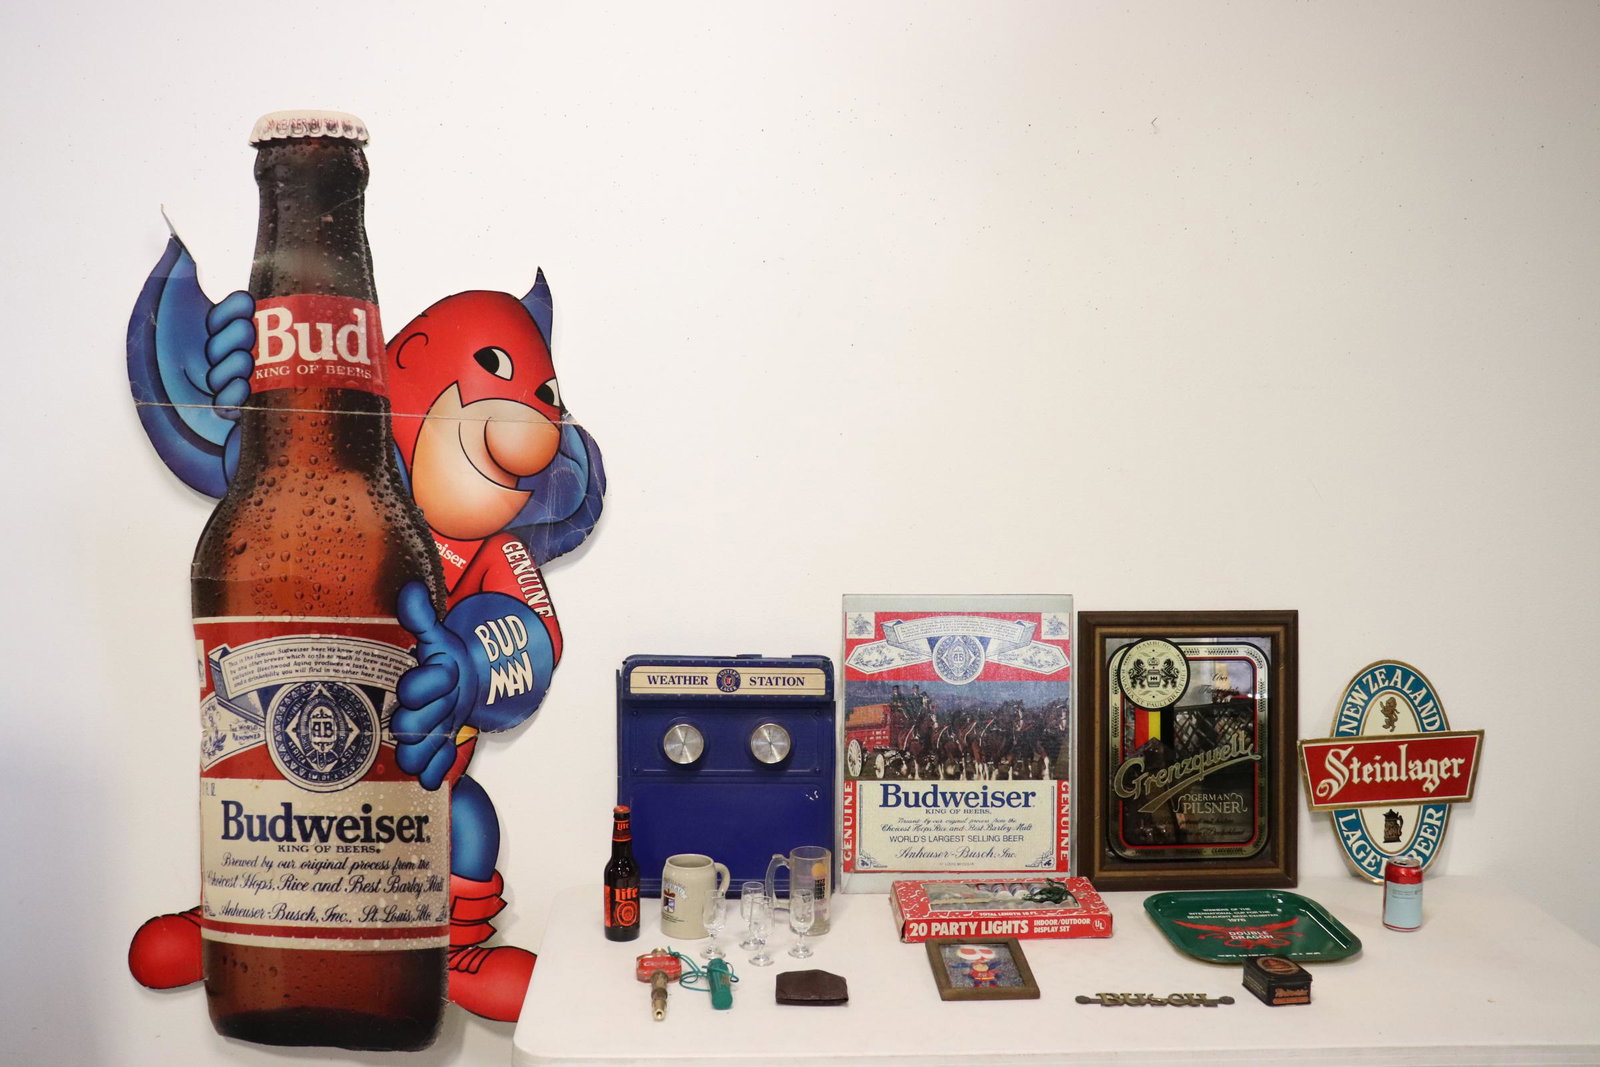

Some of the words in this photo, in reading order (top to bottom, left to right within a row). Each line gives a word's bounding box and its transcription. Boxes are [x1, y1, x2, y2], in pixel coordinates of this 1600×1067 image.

[255, 307, 371, 366] Bud
[255, 365, 291, 380] KING
[296, 364, 319, 375] OF
[325, 365, 372, 379] BEERS
[474, 615, 528, 663] BUD
[254, 650, 275, 659] famous
[370, 651, 388, 660] brand
[264, 656, 284, 664] brewer
[363, 657, 378, 665] brew
[256, 662, 291, 672] Beechwood
[247, 670, 280, 683] drinkability
[341, 668, 359, 676] other
[360, 670, 375, 679] beer
[384, 676, 396, 685] any
[486, 651, 533, 705] MAN
[647, 674, 709, 686] WEATHER
[749, 676, 806, 687] STATION
[1339, 685, 1369, 736] NEW
[1363, 668, 1441, 731] ZEALAND
[287, 741, 308, 764] AFRICA
[341, 744, 357, 764] ASIA
[1114, 731, 1256, 800] Grenzquell
[1316, 743, 1466, 801] Steinlager
[879, 783, 1037, 808] Budweiser
[1189, 793, 1230, 802] GERMAN
[1183, 801, 1242, 814] PILSNER
[220, 799, 430, 844] Budweiser
[616, 823, 630, 831] Lite
[843, 780, 853, 862] GENUINE
[880, 823, 912, 832] Choicest
[965, 823, 984, 832] Best
[983, 823, 1012, 833] Barley
[1013, 822, 1033, 832] Malt
[1060, 781, 1070, 861] GENUINE
[928, 834, 965, 843] LARGEST
[967, 834, 1001, 843] SELLING
[1002, 834, 1024, 842] BEER
[278, 845, 310, 853] KING
[314, 845, 331, 854] OF
[997, 847, 1017, 859] Inc.
[220, 851, 259, 868] Brewed
[260, 855, 274, 872] by
[276, 860, 297, 869] our
[299, 856, 349, 875] original
[347, 860, 390, 875] process
[390, 856, 416, 875] from
[416, 858, 430, 870] the
[276, 872, 310, 892] Rice
[311, 876, 344, 893] and
[344, 874, 382, 894] Best
[382, 874, 424, 899] Barley
[423, 874, 444, 893] Malt
[614, 887, 639, 902] Lite
[909, 923, 928, 937] 20
[930, 920, 979, 937] PARTY
[986, 919, 1029, 935] LIGHTS
[1033, 917, 1091, 926] INDOOR/OUTDOOR
[1033, 926, 1058, 934] DISPLAY
[1058, 925, 1070, 933] SET
[1094, 919, 1105, 930] UL
[1095, 992, 1219, 1008] BUSCH
